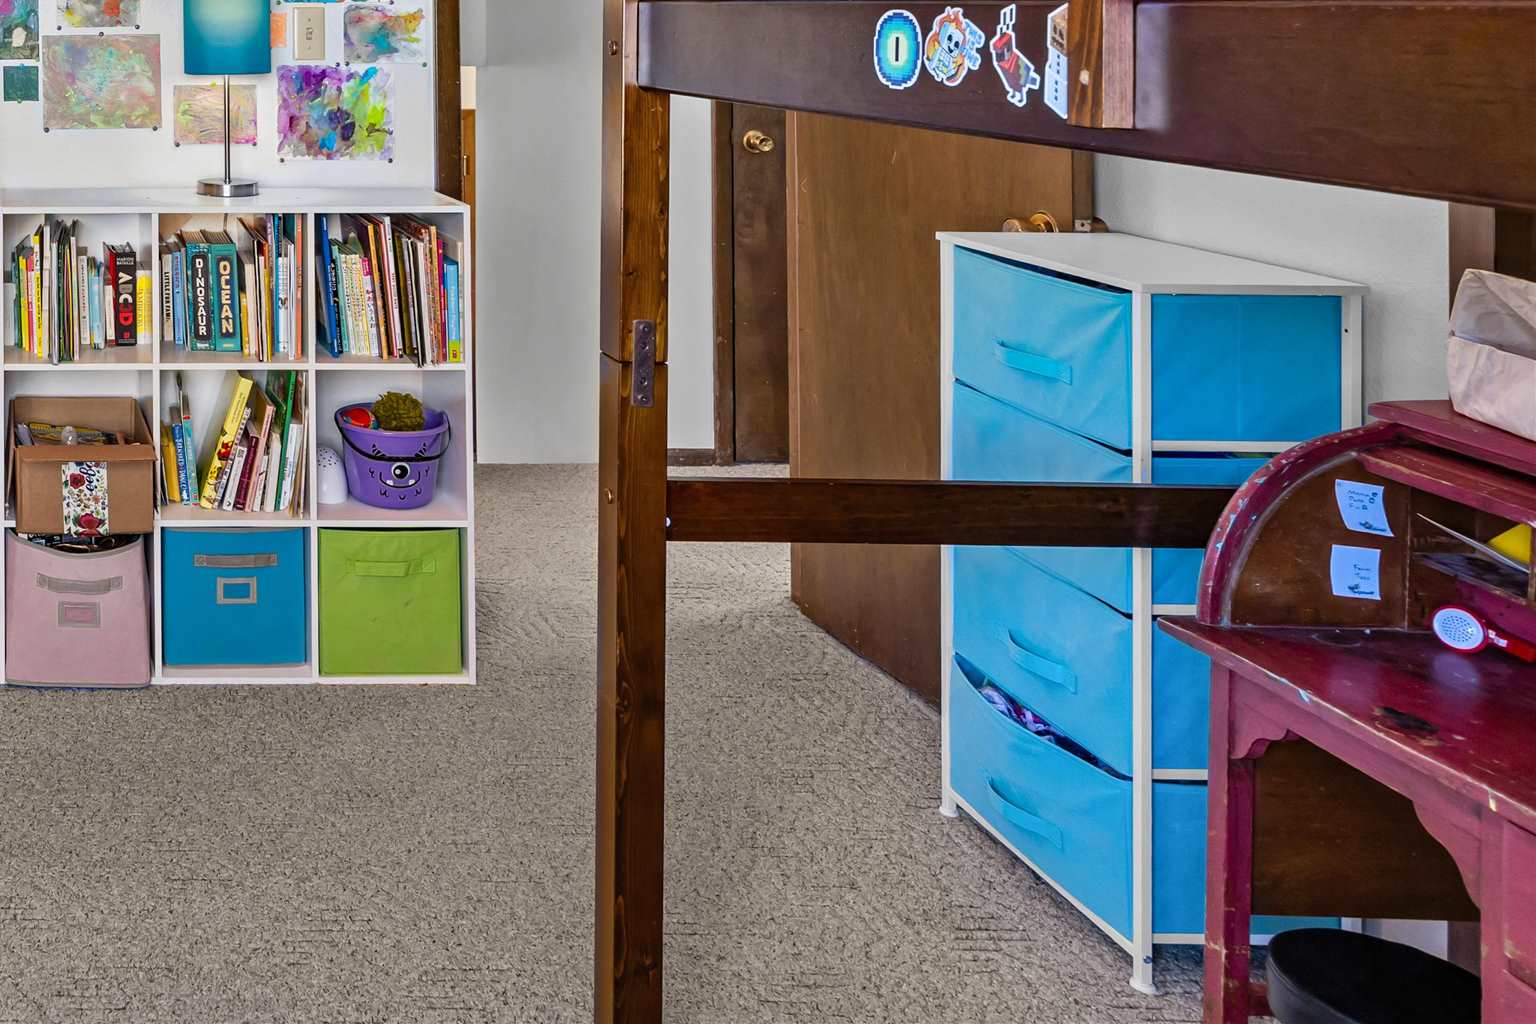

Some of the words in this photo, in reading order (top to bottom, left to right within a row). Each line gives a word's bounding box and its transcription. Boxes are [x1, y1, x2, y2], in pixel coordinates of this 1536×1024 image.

[118, 271, 133, 326] ABC3D
[195, 258, 207, 336] DINOSAUR
[219, 261, 234, 334] OCEAN
